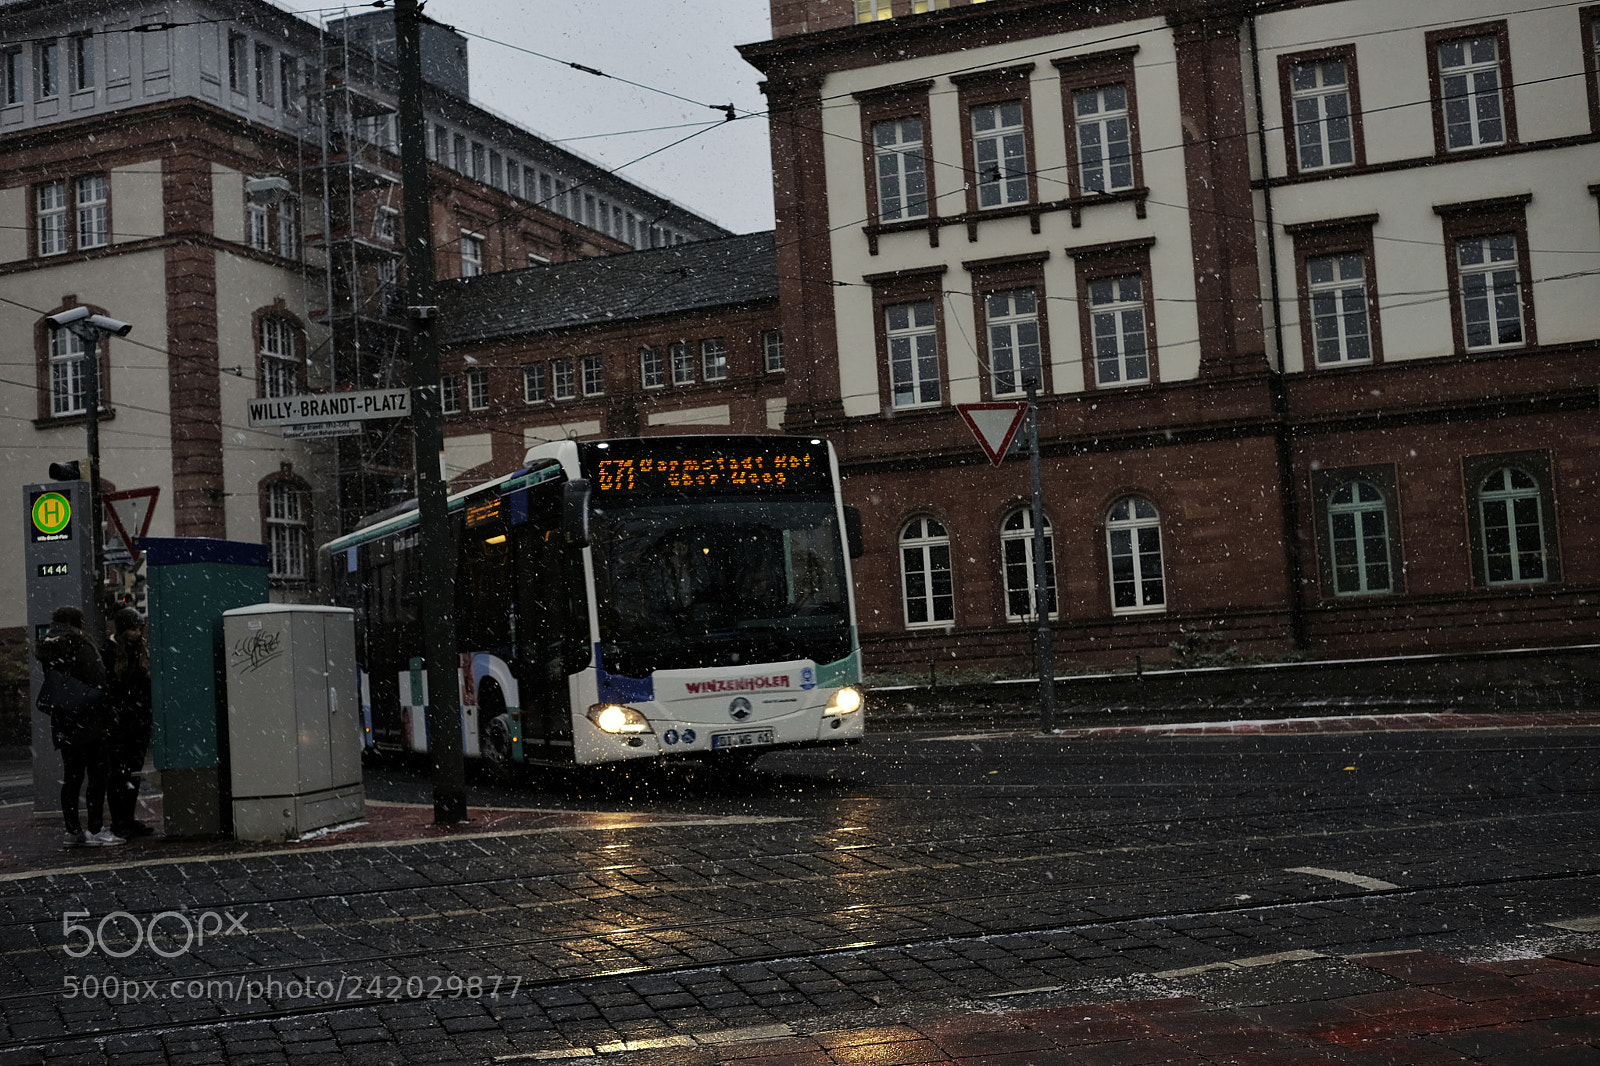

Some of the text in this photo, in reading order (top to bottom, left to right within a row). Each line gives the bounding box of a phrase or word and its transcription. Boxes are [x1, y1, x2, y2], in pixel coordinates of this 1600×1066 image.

[250, 394, 407, 421] WILLY-BRANDT-PLATZ
[598, 459, 634, 491] 671
[44, 502, 59, 524] H
[685, 675, 790, 694] WINZENHÖLER
